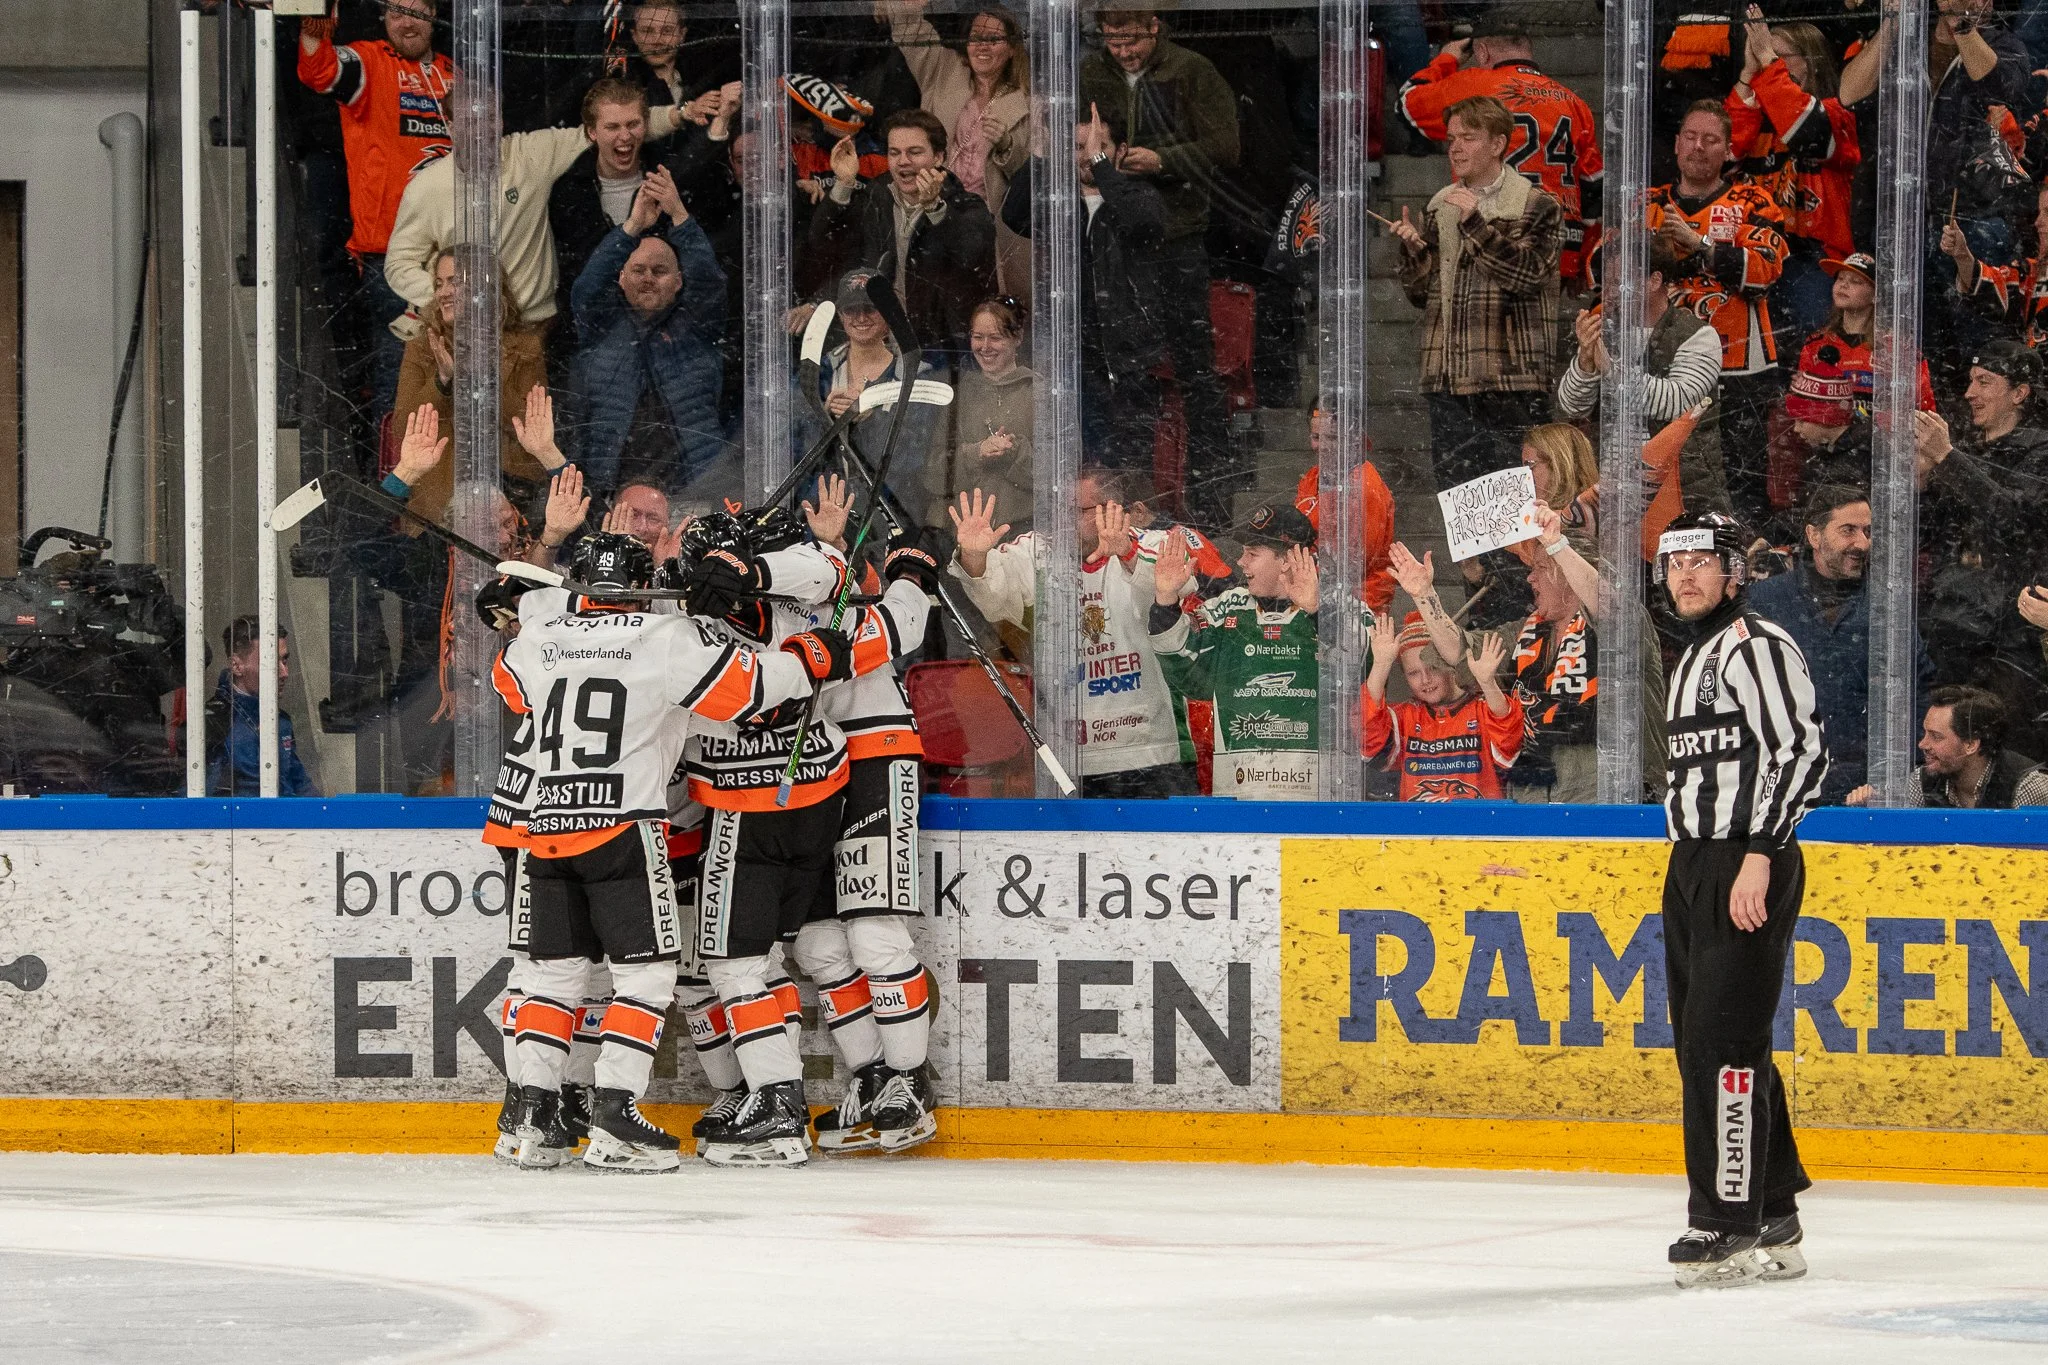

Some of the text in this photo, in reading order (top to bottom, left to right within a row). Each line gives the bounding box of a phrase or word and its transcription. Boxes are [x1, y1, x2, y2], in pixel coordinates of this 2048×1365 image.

[1505, 112, 1578, 187] 24
[598, 551, 615, 567] 49
[702, 549, 749, 576] UER
[778, 600, 813, 620] mobit
[1256, 643, 1302, 656] Nærbakst
[1088, 651, 1142, 679] INTER
[1087, 671, 1142, 698] SPORT
[539, 676, 628, 772] 49
[1091, 715, 1144, 732] Gjensidige
[1093, 731, 1117, 743] NOR
[1247, 766, 1313, 784] Nærbakst
[1418, 759, 1467, 771] PAREBANKEN
[527, 816, 616, 833] ESSMANN
[897, 763, 914, 907] DREAMWORK
[651, 821, 676, 949] DREAMWOR
[703, 810, 738, 952] DREAMWORK
[838, 872, 888, 900] dag,
[997, 854, 1046, 919] &
[1078, 852, 1252, 921] laser
[1339, 908, 2048, 1059] RAMREN
[690, 1018, 713, 1036] bit
[1724, 1100, 1745, 1198] WÜRTH
